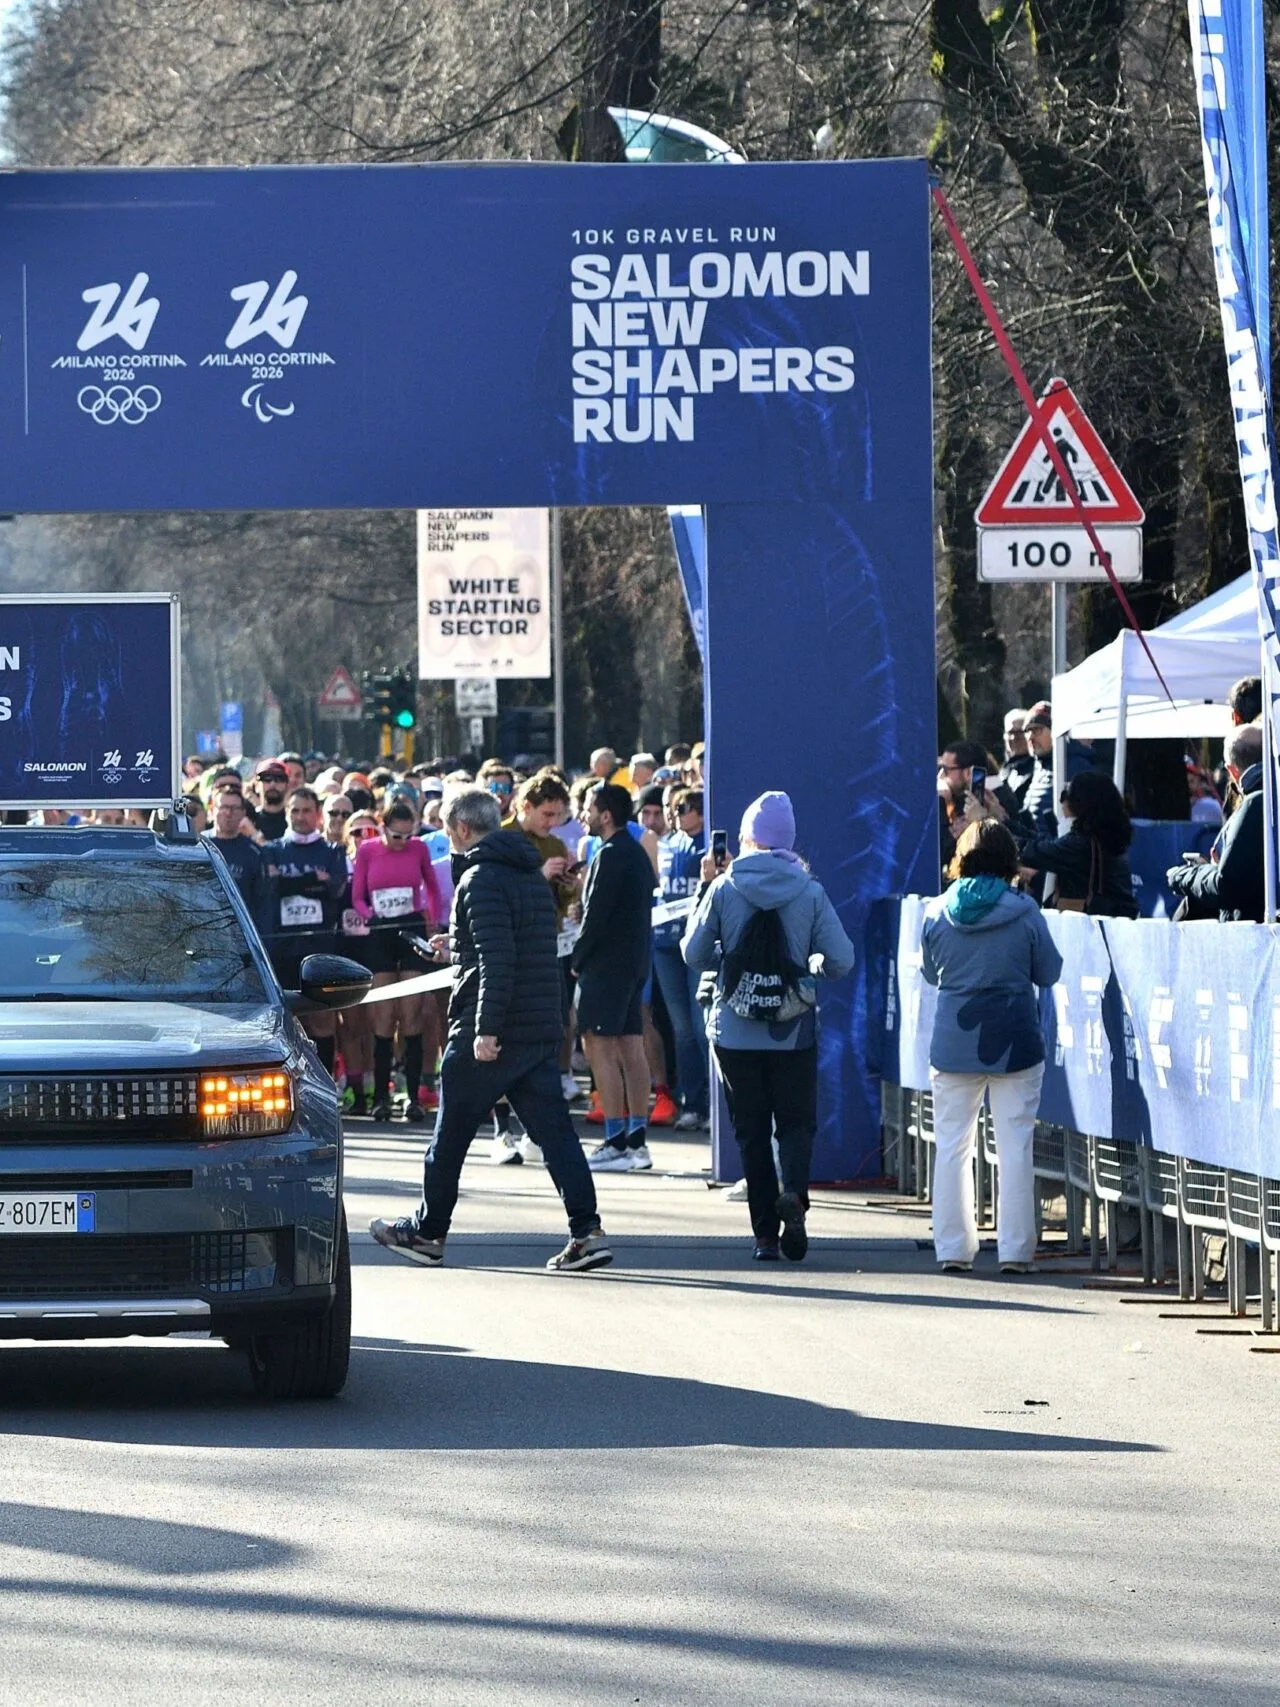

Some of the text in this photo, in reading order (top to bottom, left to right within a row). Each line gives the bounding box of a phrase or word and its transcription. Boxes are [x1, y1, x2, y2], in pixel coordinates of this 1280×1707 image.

[572, 227, 777, 245] 10K GRAVEL RUN
[571, 250, 870, 300] SALOMON
[572, 300, 709, 347] NEW
[51, 354, 187, 369] MILANO CORTINA
[199, 352, 336, 367] MILANO CORTINA
[103, 368, 135, 381] 2026
[251, 366, 284, 379] 2026
[572, 346, 855, 396] SHAPERS
[573, 396, 695, 443] RUN
[427, 511, 493, 520] SALOMON
[427, 521, 457, 531] NEW
[427, 531, 490, 542] SHAPERS
[427, 541, 454, 552] RUN
[1008, 541, 1071, 567] 100
[449, 579, 520, 594] WHITE
[428, 600, 541, 615] STARTING
[441, 620, 528, 636] SECTOR
[23, 763, 87, 772] SALOMON
[286, 905, 317, 916] 5273
[379, 898, 410, 909] 5352
[741, 971, 783, 987] ALOMON
[733, 993, 782, 1008] HAPERS
